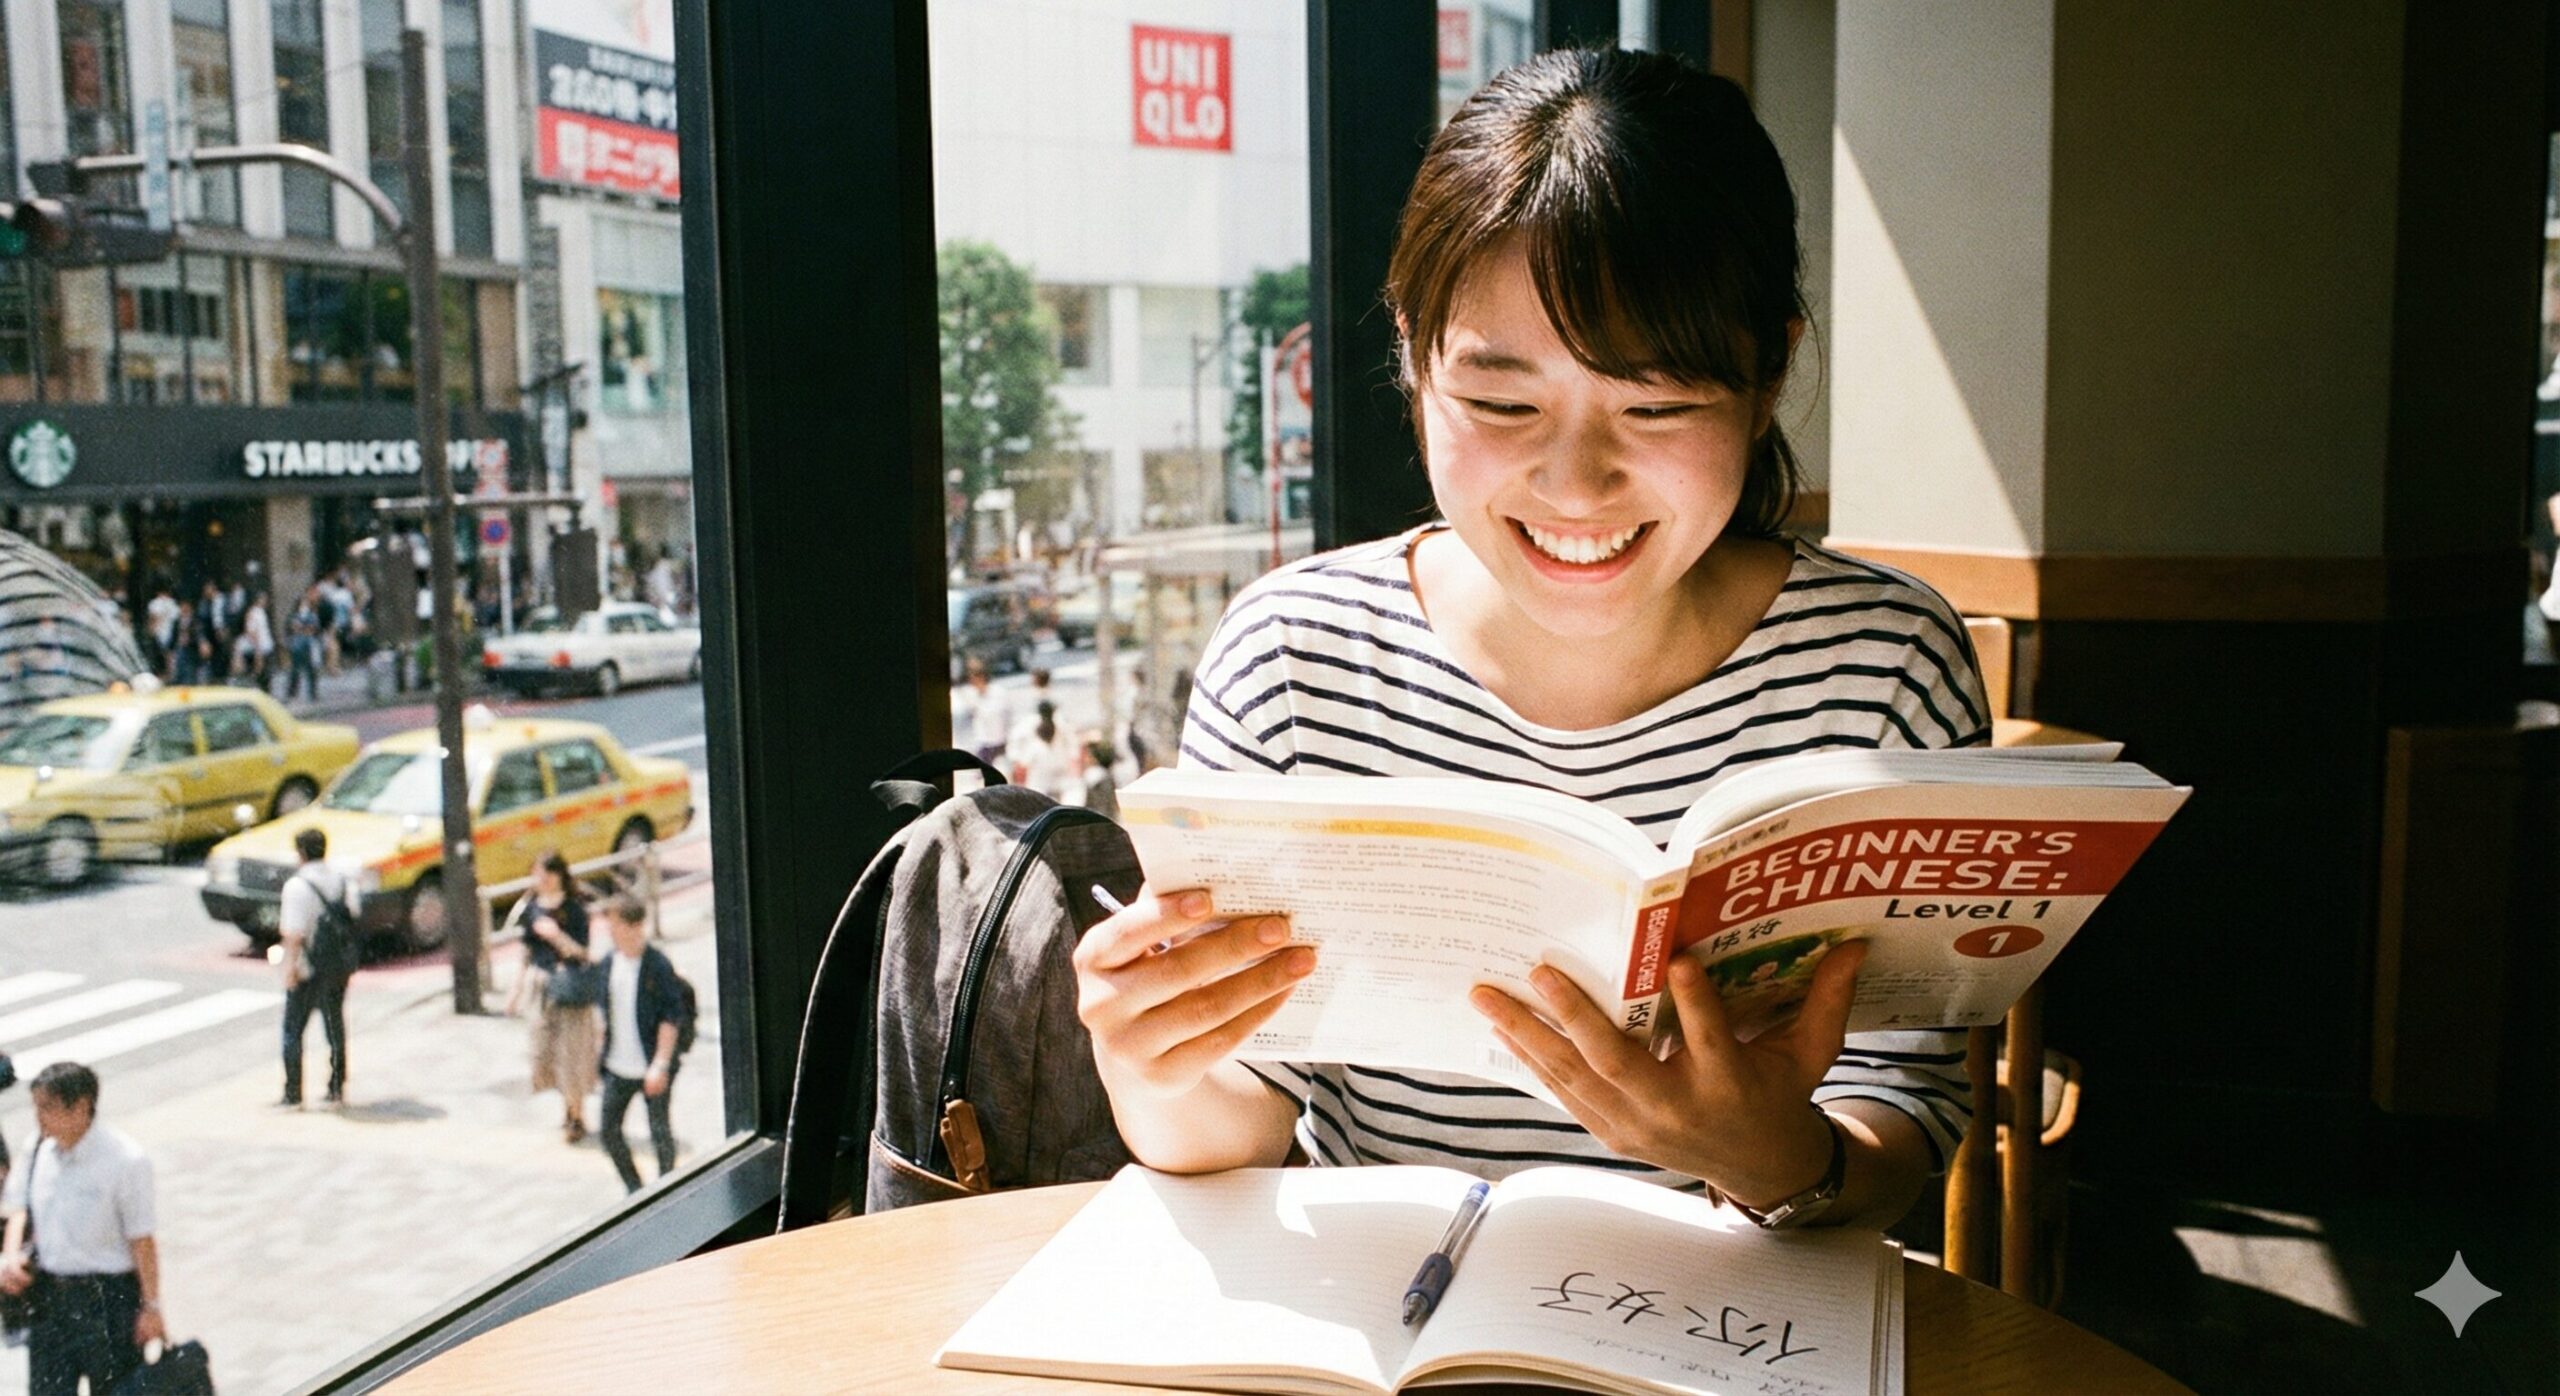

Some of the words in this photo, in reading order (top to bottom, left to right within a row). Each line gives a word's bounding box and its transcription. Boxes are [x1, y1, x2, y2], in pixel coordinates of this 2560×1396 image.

[1139, 38, 1219, 90] UNI
[1140, 90, 1226, 143] QLO
[244, 439, 422, 478] STARBUCKS
[1724, 828, 2078, 892] BEGINNER'S
[1719, 859, 2069, 922] CHINESE:
[1884, 898, 2013, 920] Level
[2033, 899, 2052, 920] 1
[1986, 931, 2014, 954] 1
[1625, 1001, 1652, 1032] HSK
